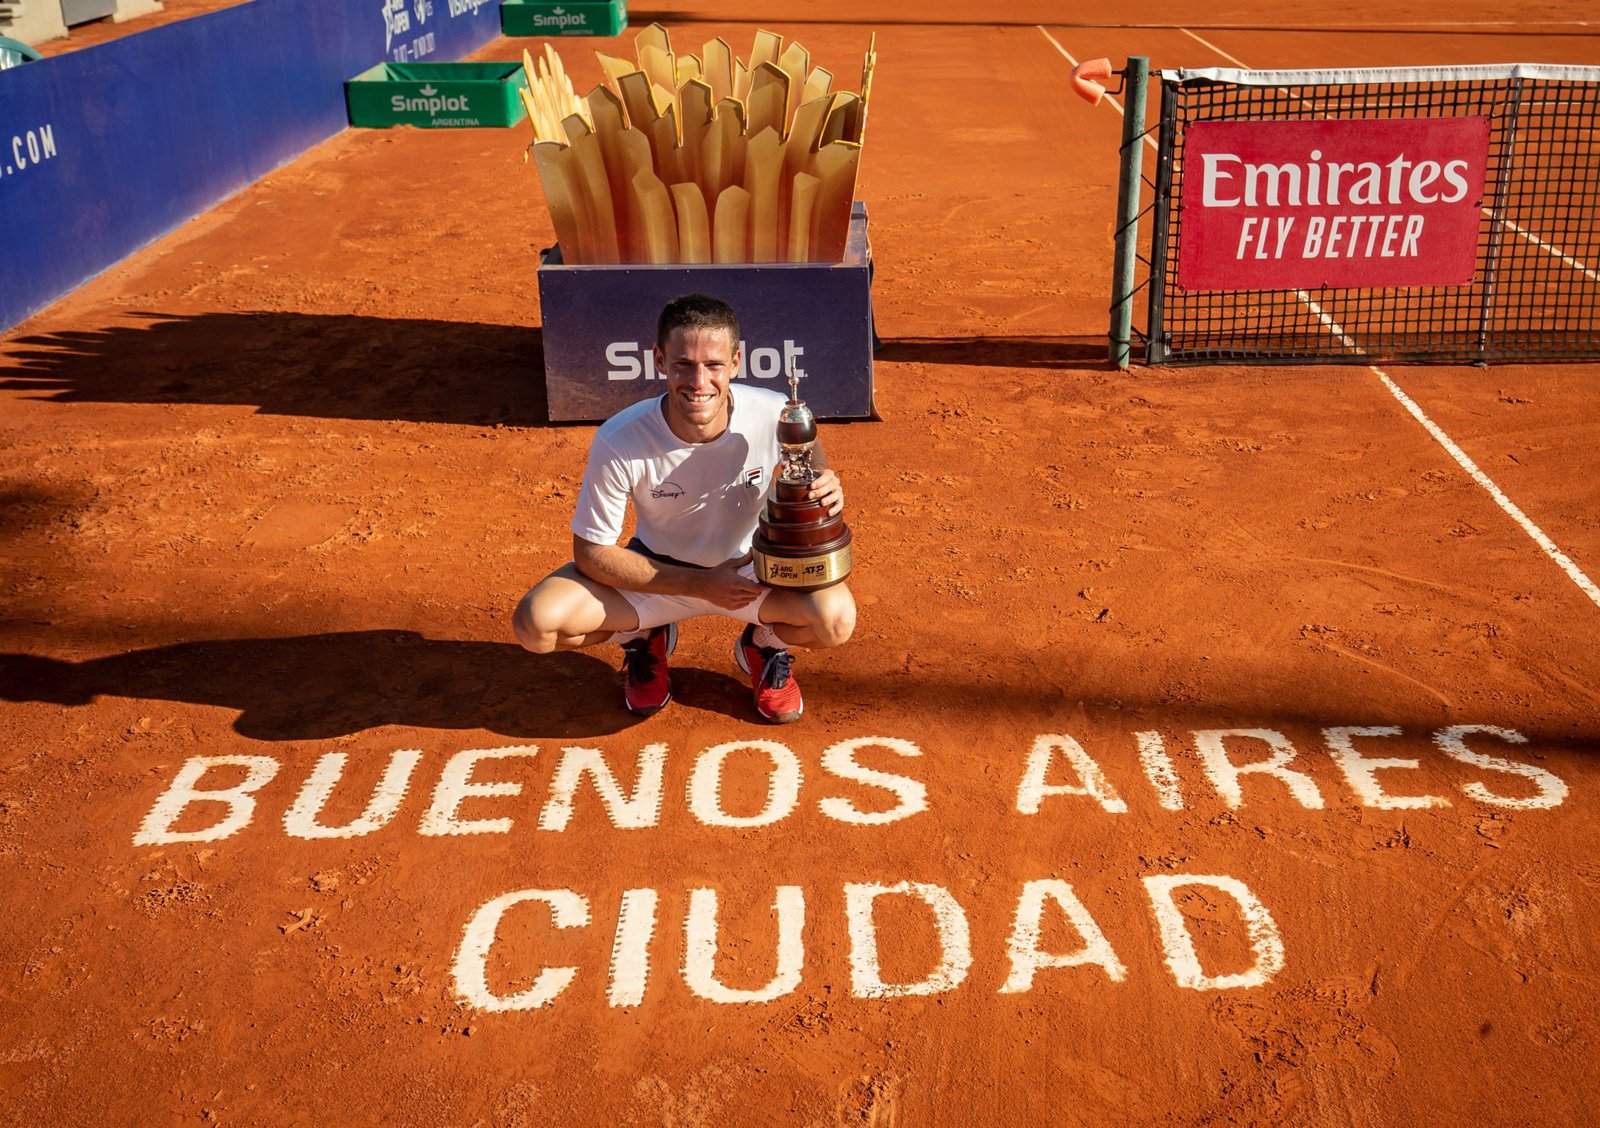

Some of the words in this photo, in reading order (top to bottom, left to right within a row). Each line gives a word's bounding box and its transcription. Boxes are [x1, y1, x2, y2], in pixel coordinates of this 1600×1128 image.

[533, 13, 586, 29] Simplot
[391, 95, 470, 116] Simplot
[431, 118, 479, 126] ARGENTINA
[0, 124, 57, 178] .COM
[1201, 150, 1468, 207] Emirates
[1236, 217, 1294, 259] FLY
[1302, 215, 1424, 258] BETTER
[802, 565, 824, 575] ATP
[132, 737, 929, 847] BUENOS
[1016, 724, 1570, 813] AIRES
[449, 874, 1285, 1013] CIUDAD
